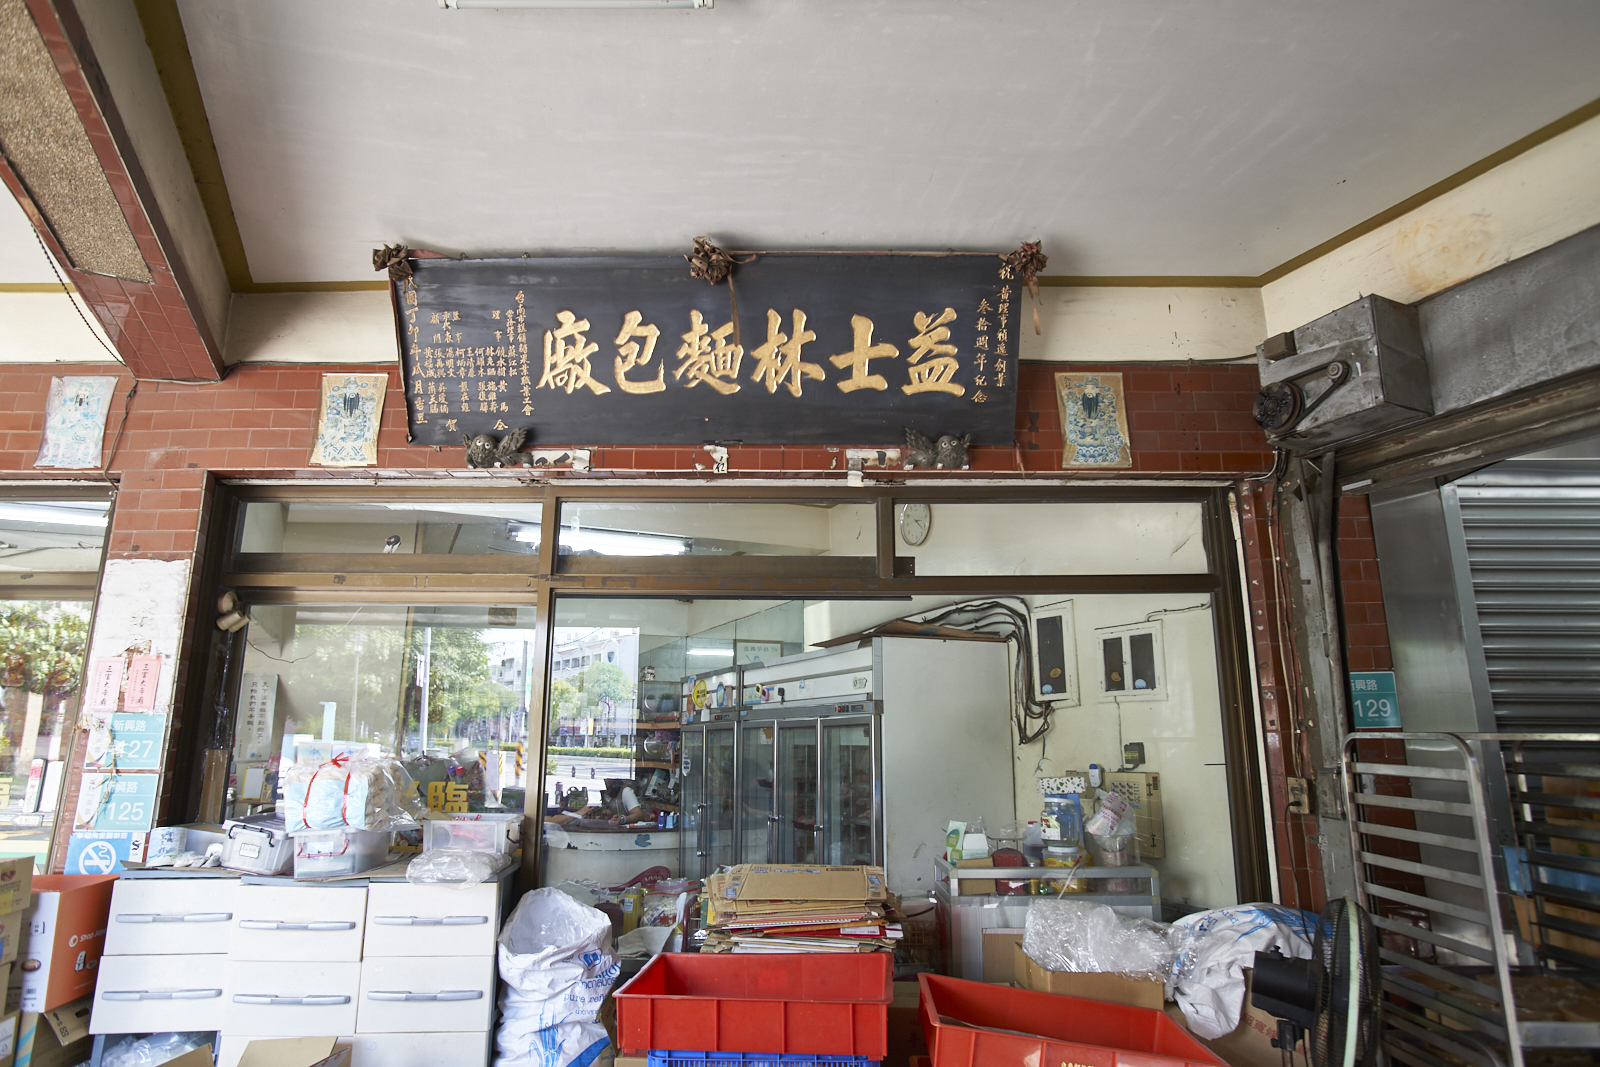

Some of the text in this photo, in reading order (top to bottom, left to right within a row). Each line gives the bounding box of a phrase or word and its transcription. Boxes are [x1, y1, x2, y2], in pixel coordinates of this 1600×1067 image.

[535, 306, 966, 398] 益士林麵包廠
[1354, 698, 1391, 718] 129
[112, 719, 147, 732] 新興路
[103, 781, 138, 794] 新興路
[107, 801, 144, 821] 125
[563, 993, 586, 1003] pure
